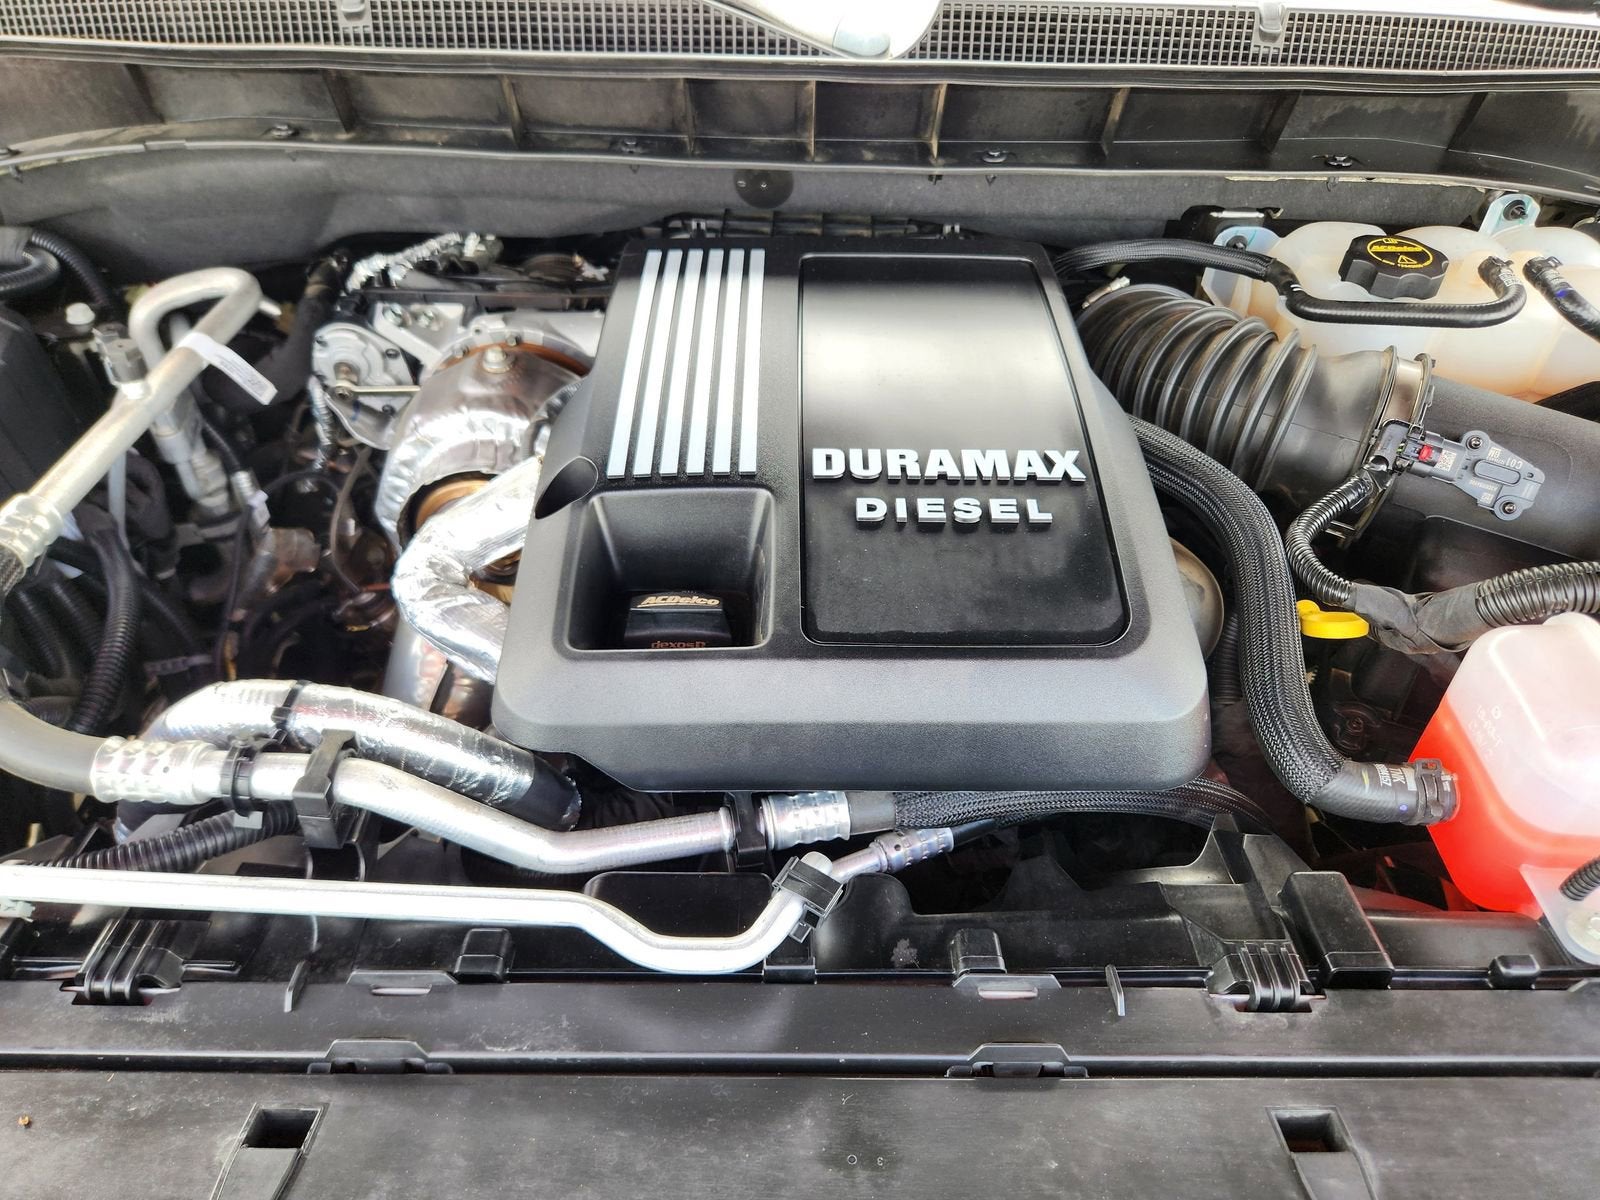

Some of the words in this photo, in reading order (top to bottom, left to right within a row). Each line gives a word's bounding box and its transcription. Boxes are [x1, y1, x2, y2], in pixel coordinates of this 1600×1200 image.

[812, 448, 1086, 481] DURAMAX
[856, 497, 1053, 523] DIESEL
[638, 595, 720, 607] ACDelco
